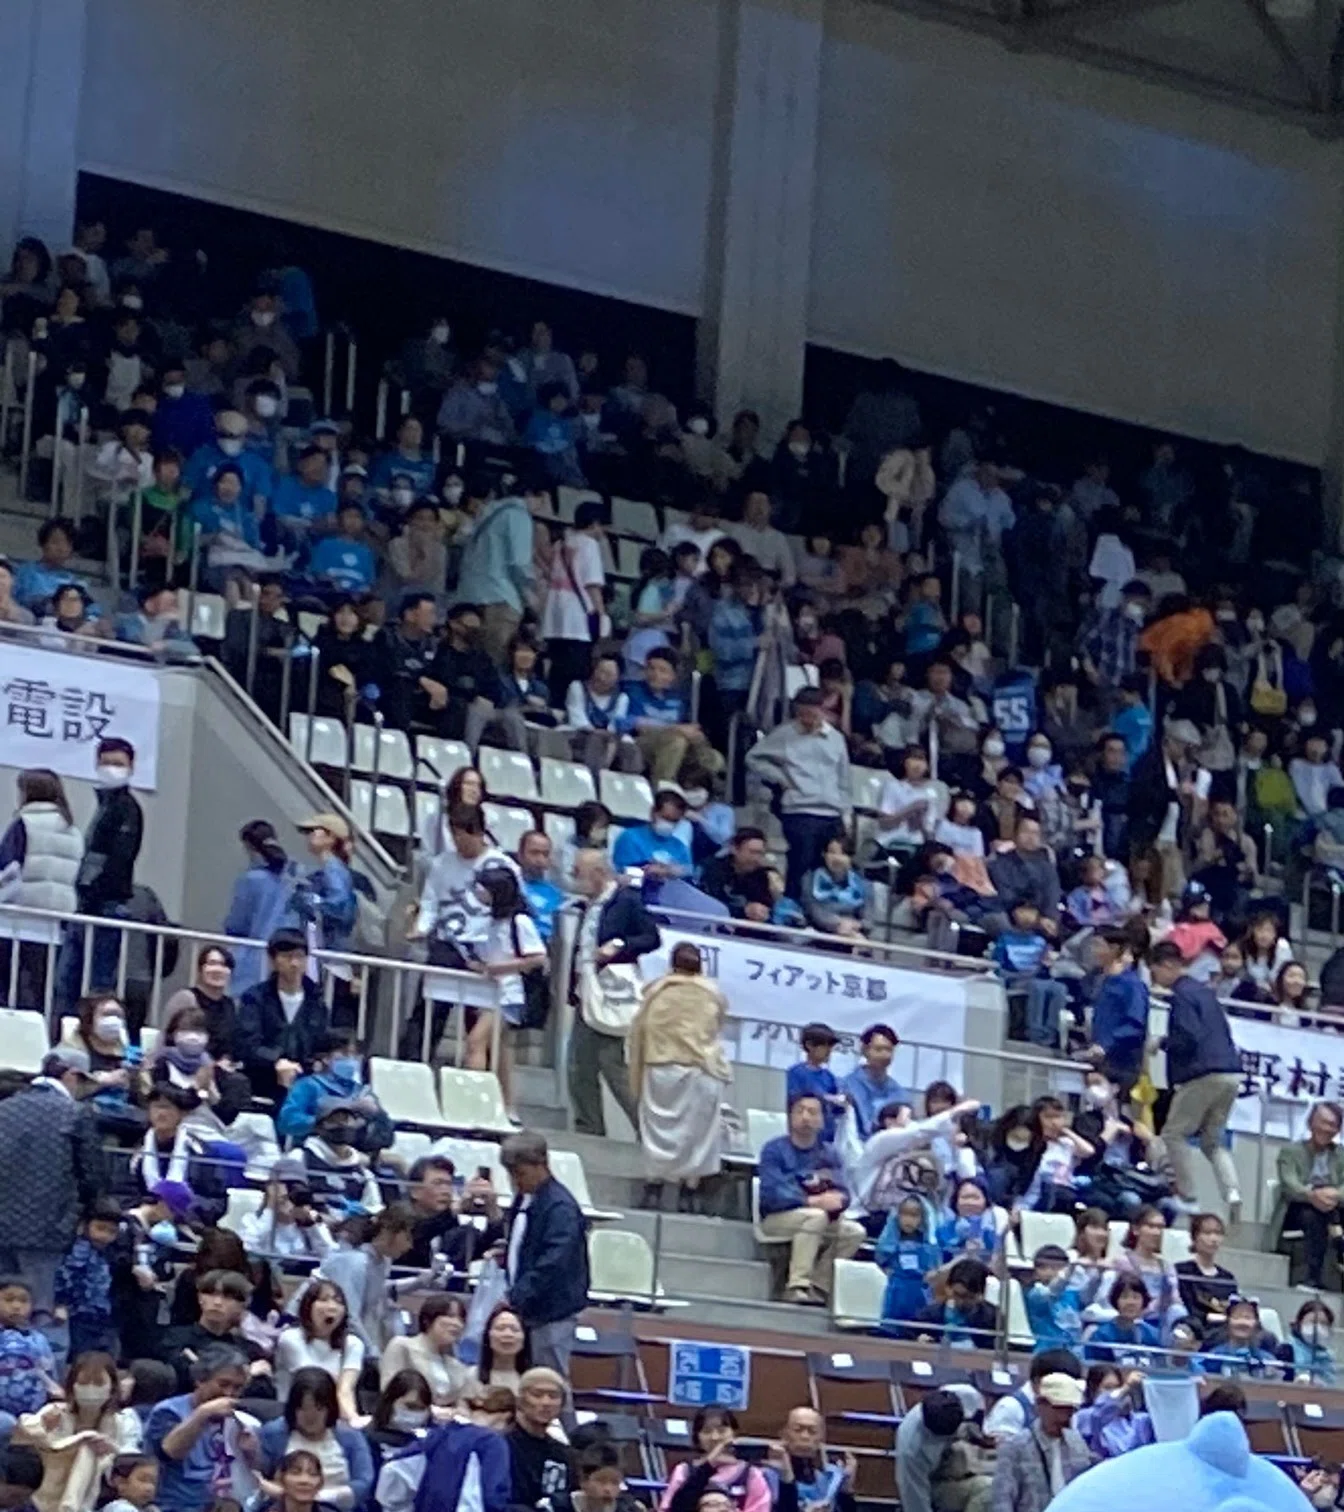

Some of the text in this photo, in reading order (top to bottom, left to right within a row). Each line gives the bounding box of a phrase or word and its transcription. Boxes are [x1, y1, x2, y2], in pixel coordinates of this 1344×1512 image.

[3, 677, 117, 742] 電設
[745, 957, 888, 1001] フィアット京都
